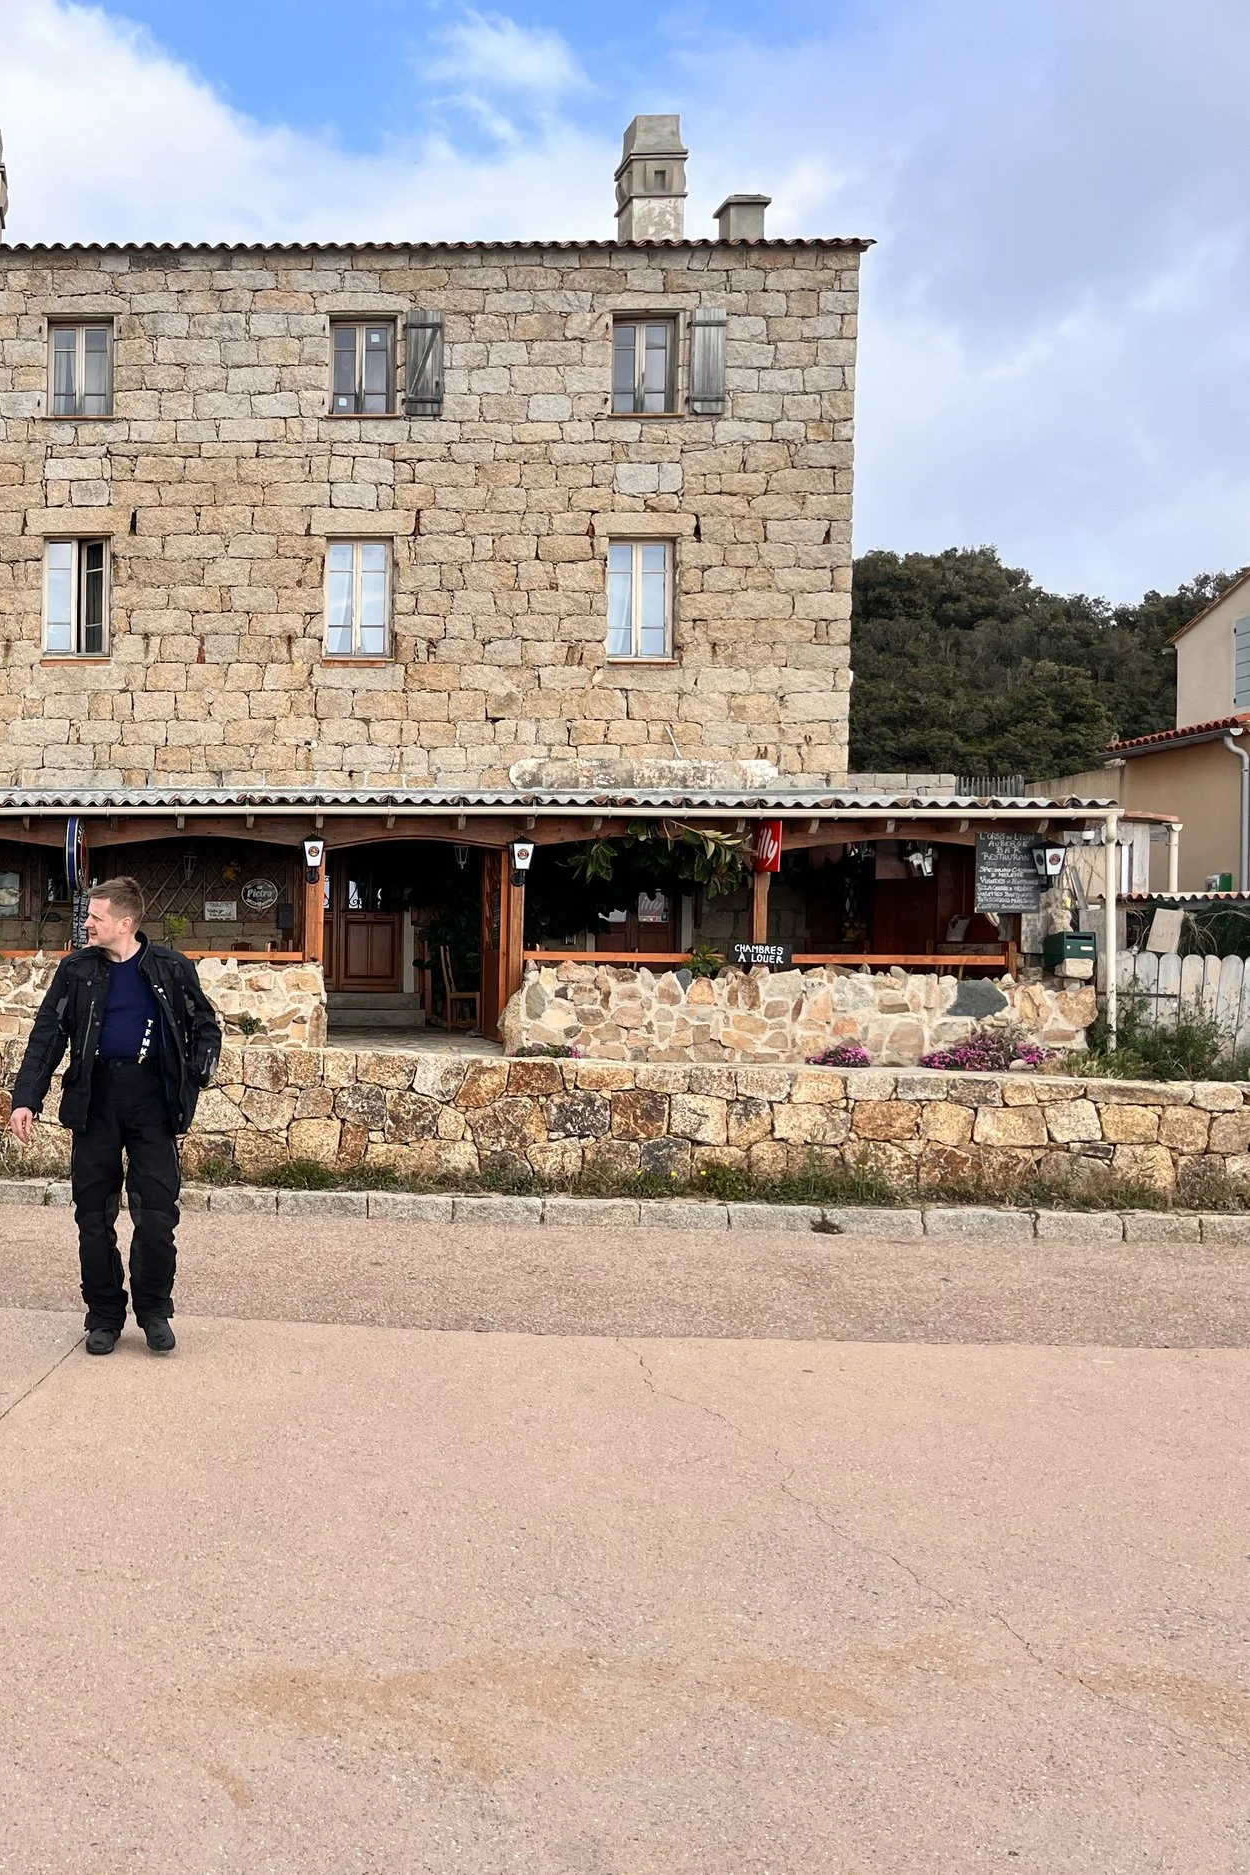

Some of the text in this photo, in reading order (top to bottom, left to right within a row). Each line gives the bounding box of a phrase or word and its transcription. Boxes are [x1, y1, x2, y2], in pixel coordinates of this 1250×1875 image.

[1014, 832, 1035, 841] LION
[756, 828, 778, 867] illy
[996, 846, 1021, 854] BAR
[246, 888, 273, 898] Pietra
[734, 943, 784, 956] CHAMBRES
[751, 953, 784, 964] LOUER
